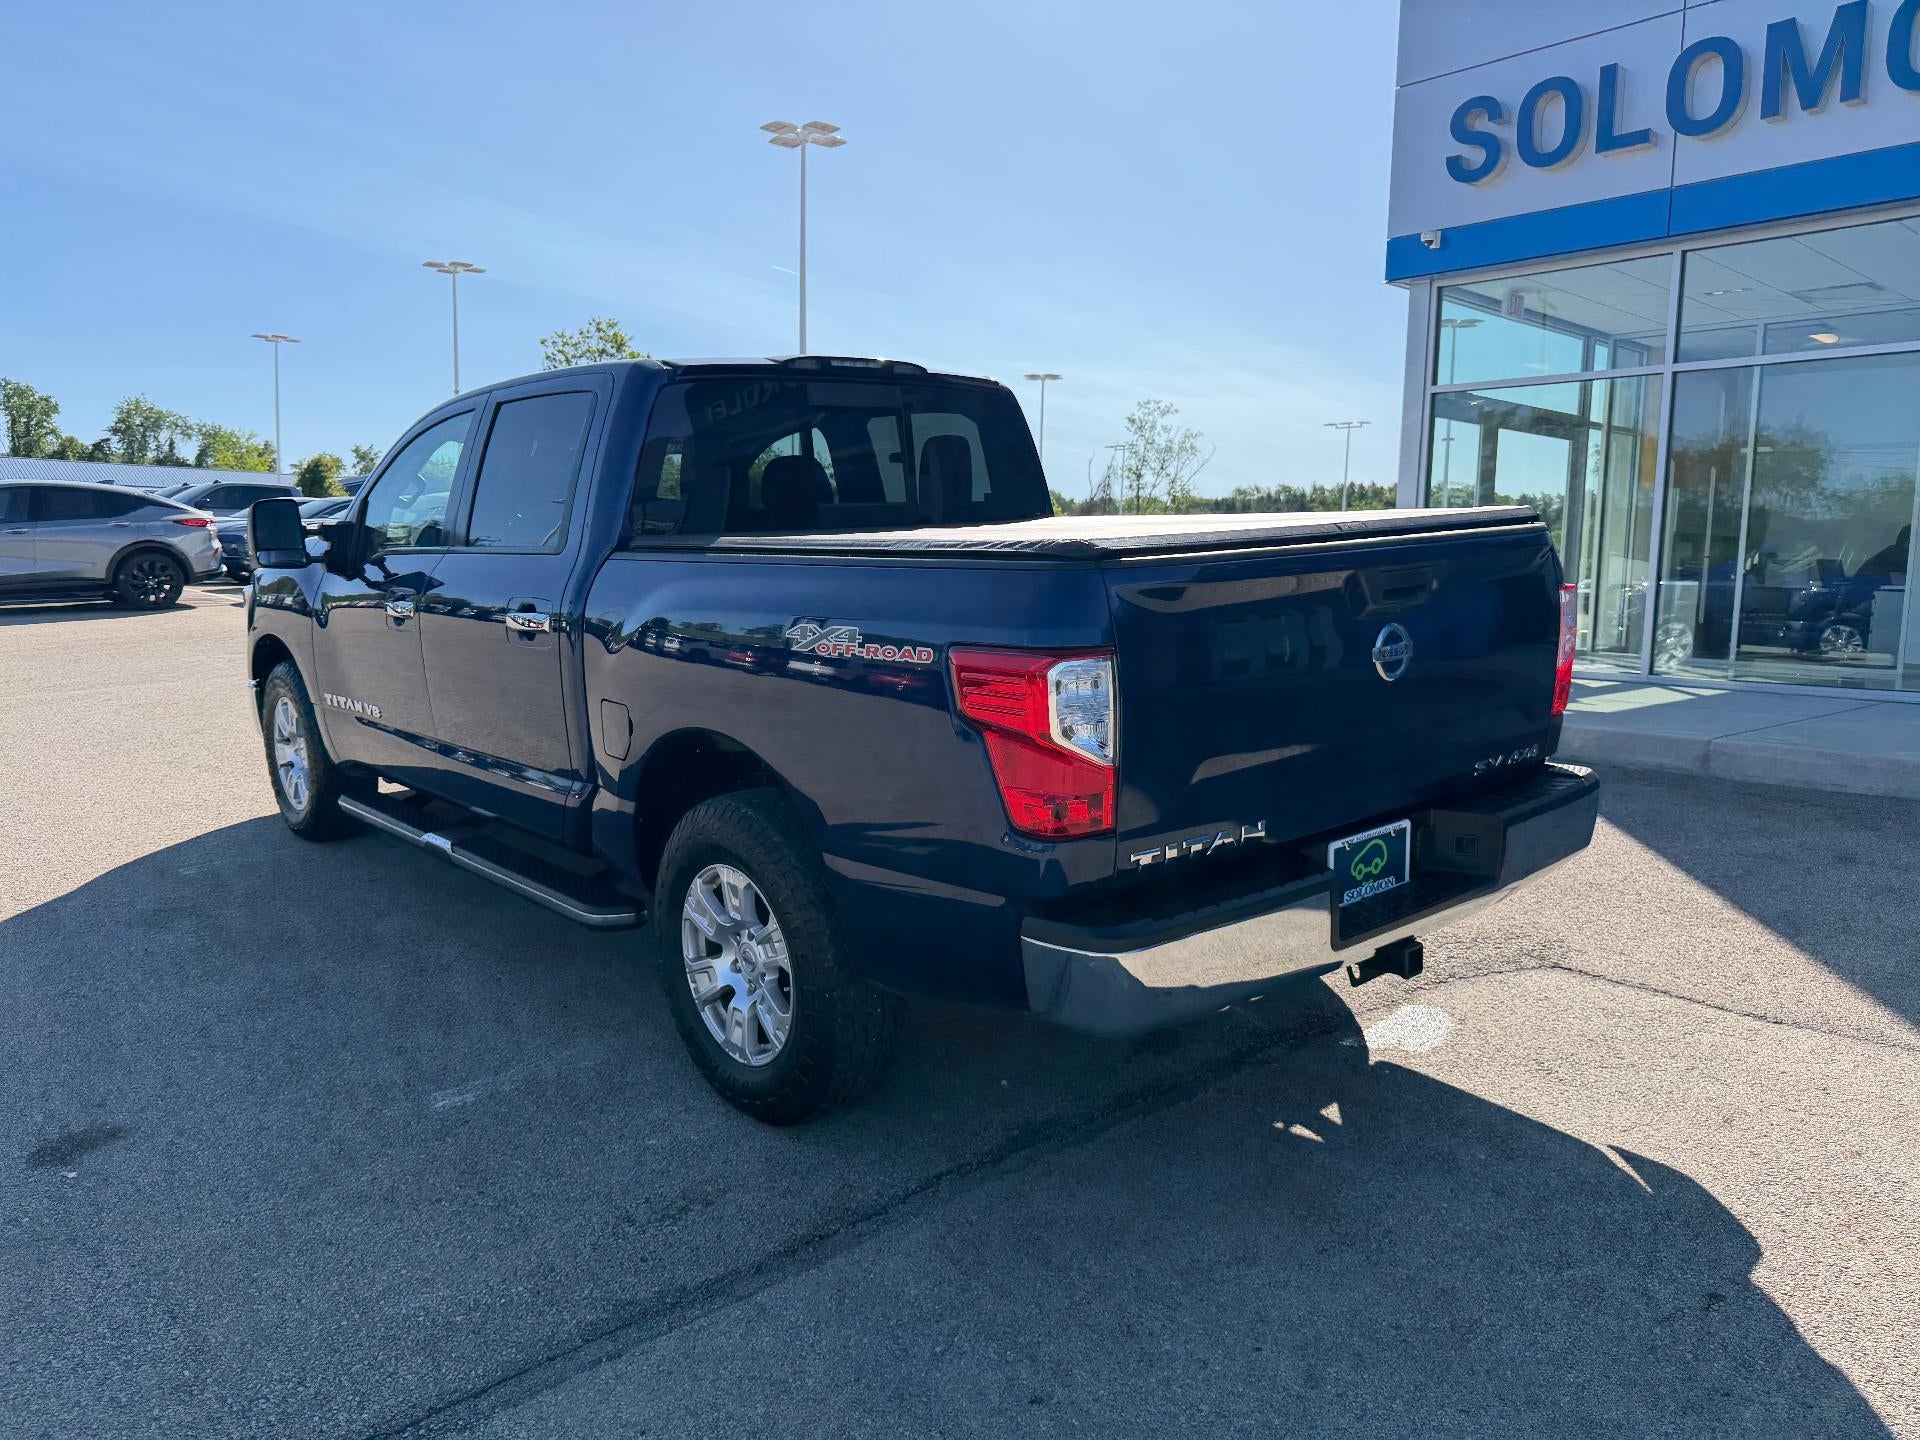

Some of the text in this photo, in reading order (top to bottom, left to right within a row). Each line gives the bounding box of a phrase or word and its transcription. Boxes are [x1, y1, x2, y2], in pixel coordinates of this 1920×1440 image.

[815, 642, 934, 664] OFF-ROAD
[323, 692, 364, 713] TITAN
[1344, 876, 1396, 902] SOLOMON
